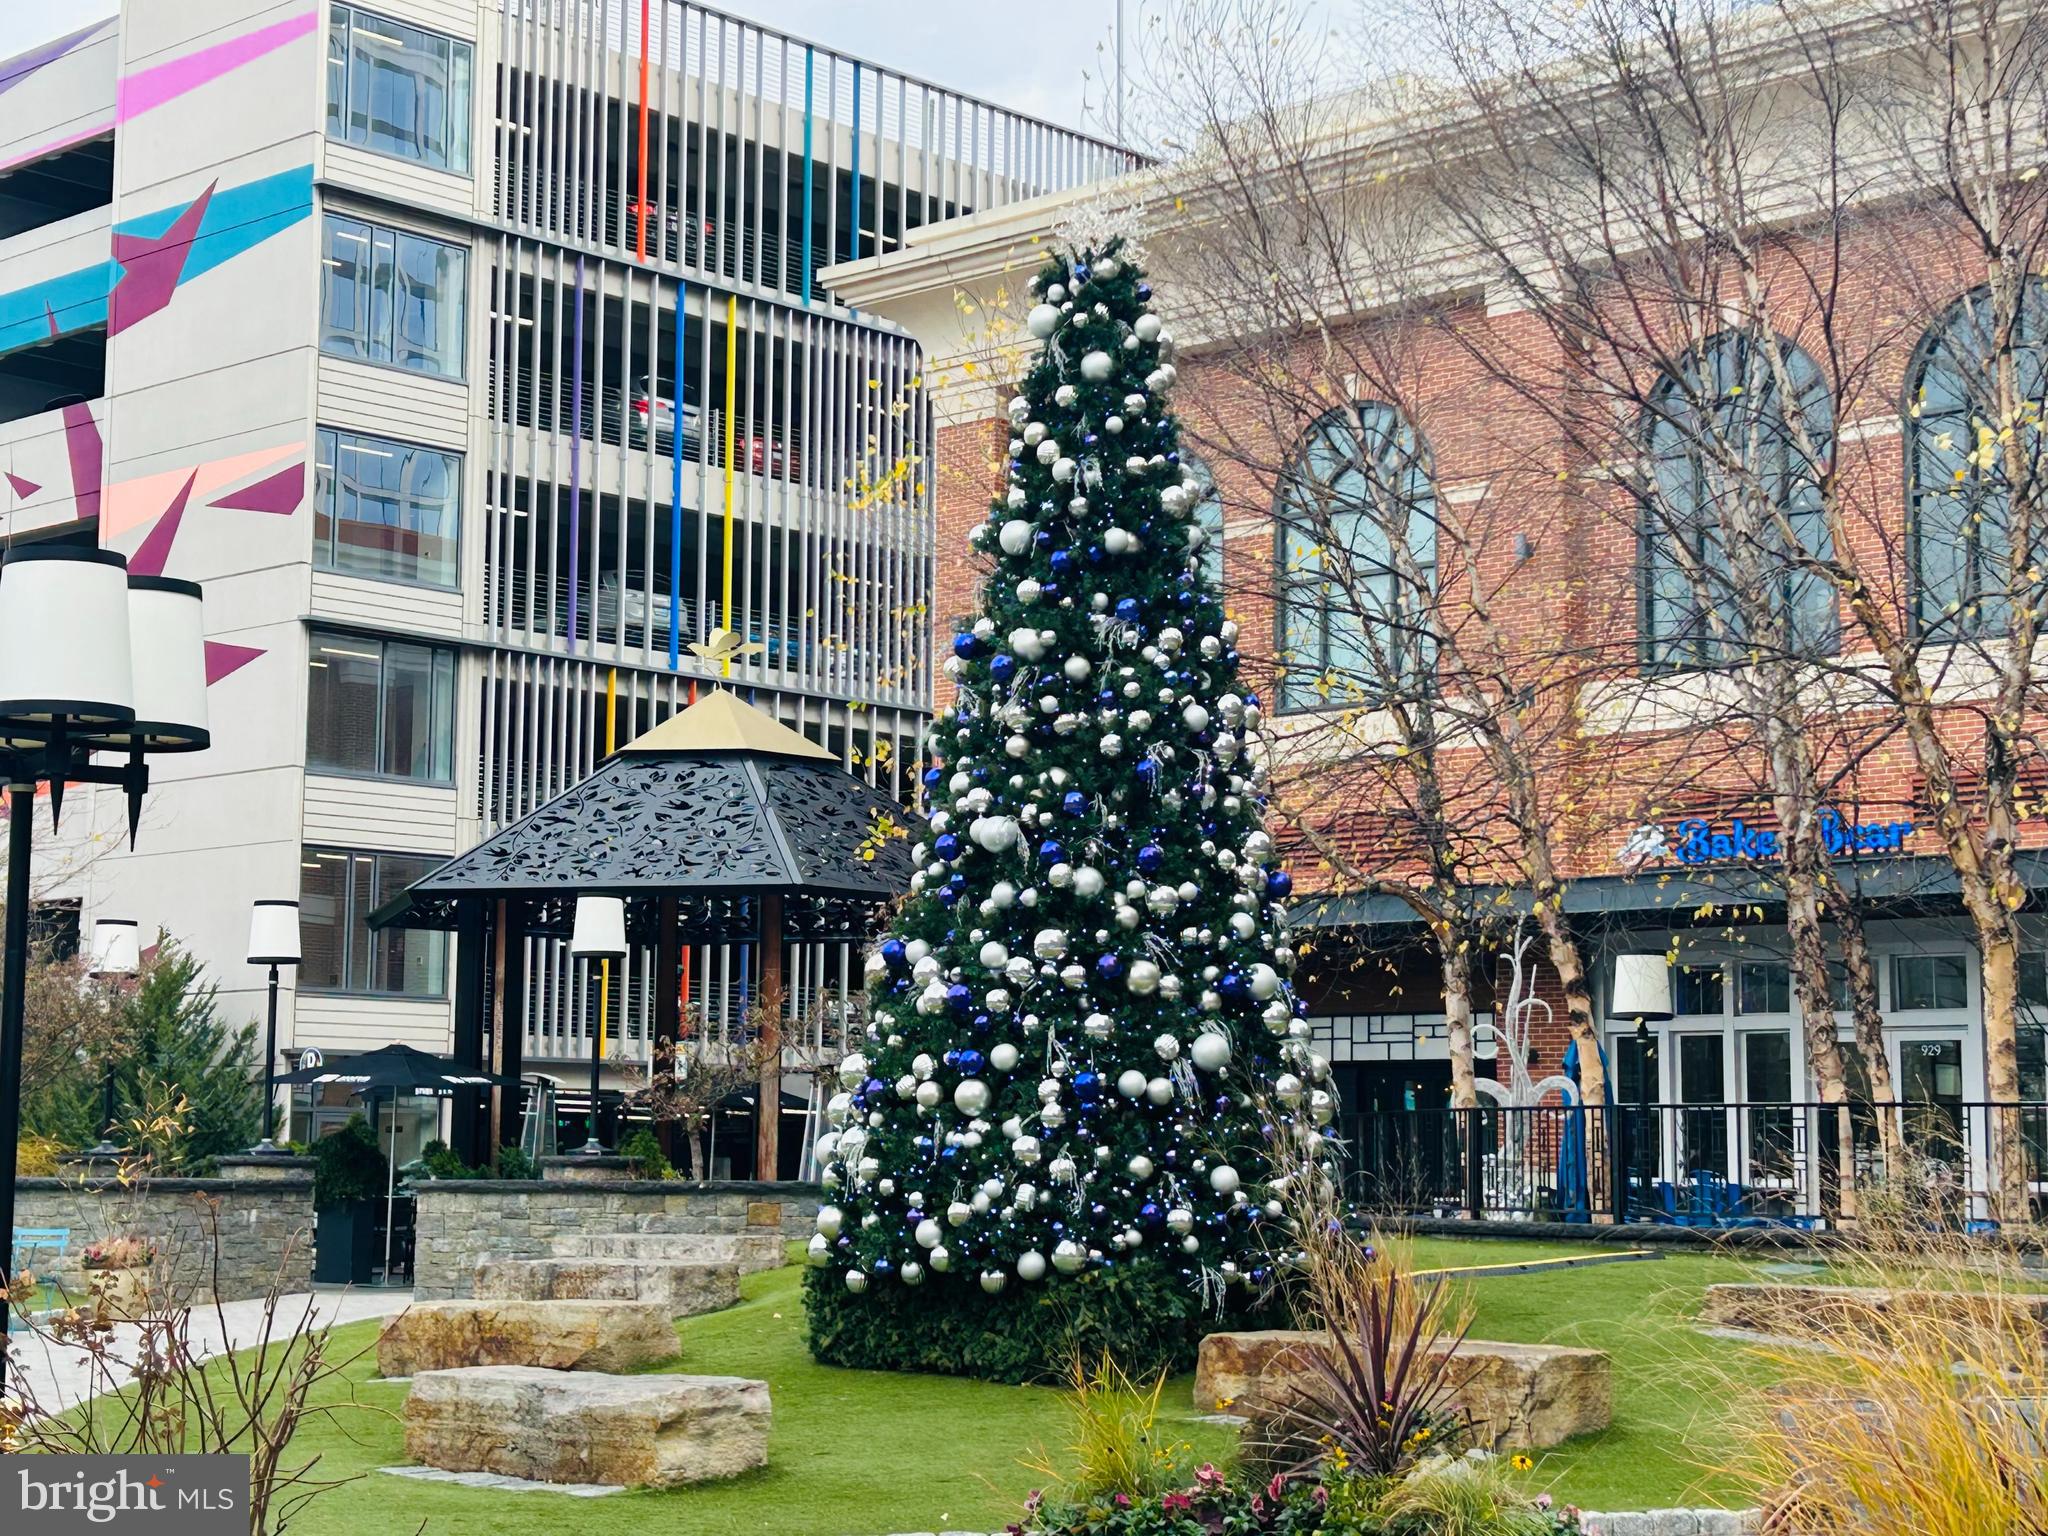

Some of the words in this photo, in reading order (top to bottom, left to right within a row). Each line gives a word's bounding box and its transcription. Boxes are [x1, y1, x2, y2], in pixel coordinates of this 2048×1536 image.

[1676, 817, 1780, 863] Bake
[1815, 808, 1913, 855] Bear
[1921, 1044, 1941, 1056] 929
